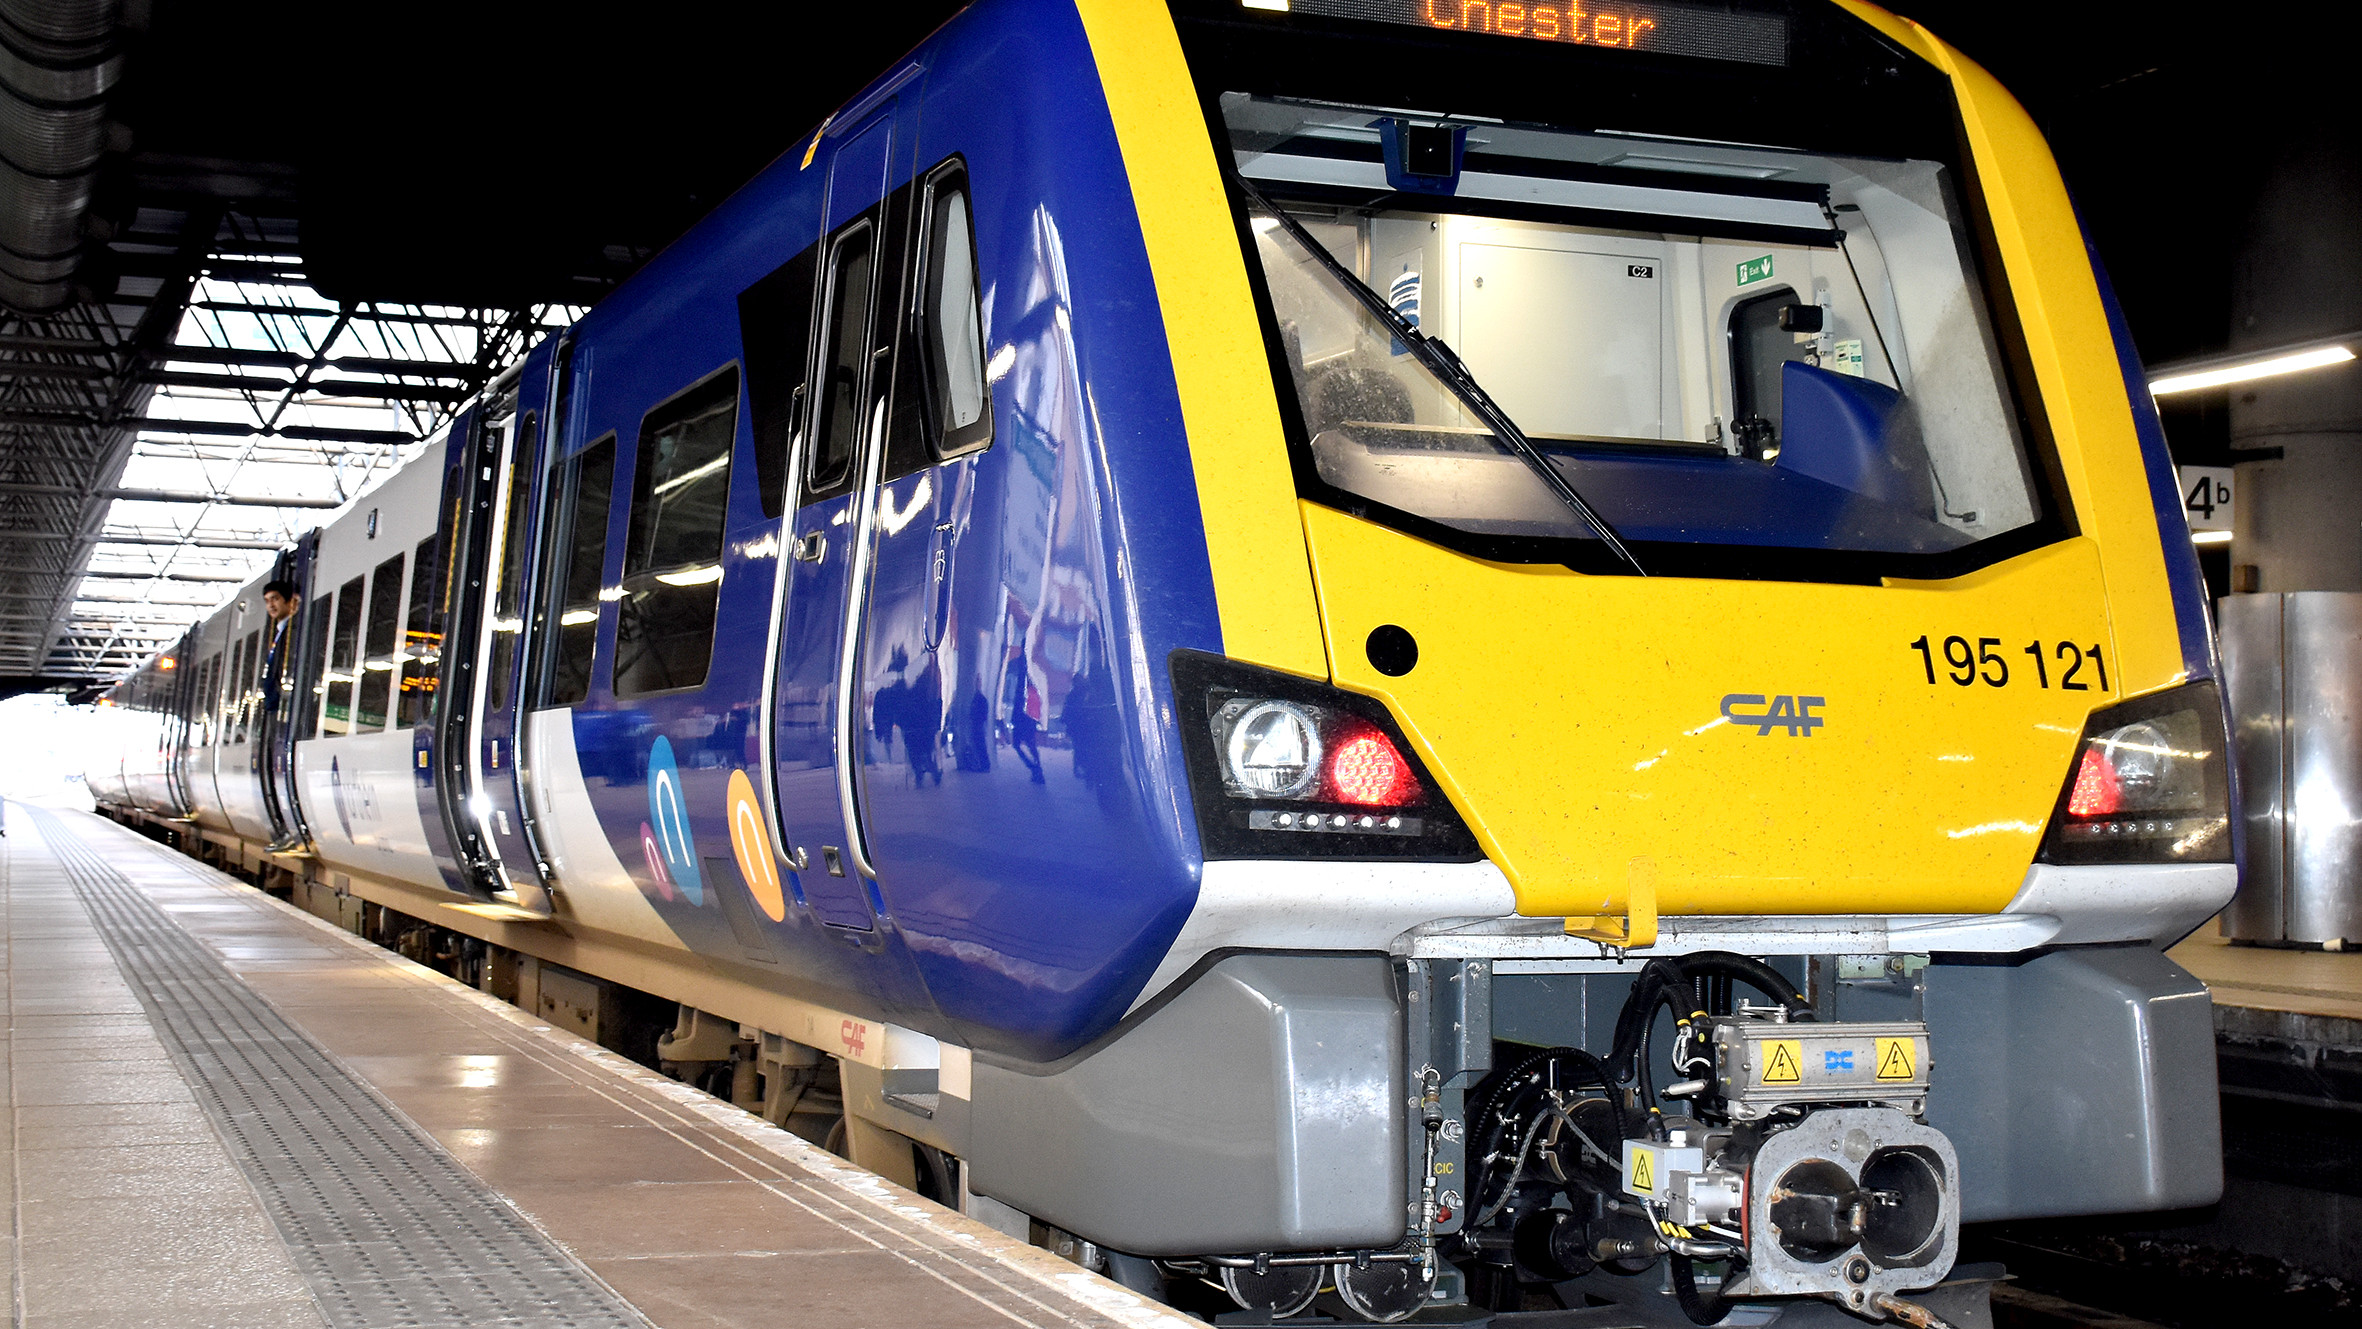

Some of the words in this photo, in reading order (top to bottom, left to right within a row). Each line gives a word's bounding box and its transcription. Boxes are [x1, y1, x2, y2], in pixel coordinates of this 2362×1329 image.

[1632, 265, 1648, 277] C2
[1910, 635, 2009, 688] 195
[2024, 640, 2109, 692] 121
[1720, 693, 1826, 737] CAF
[841, 1019, 866, 1057] CAF
